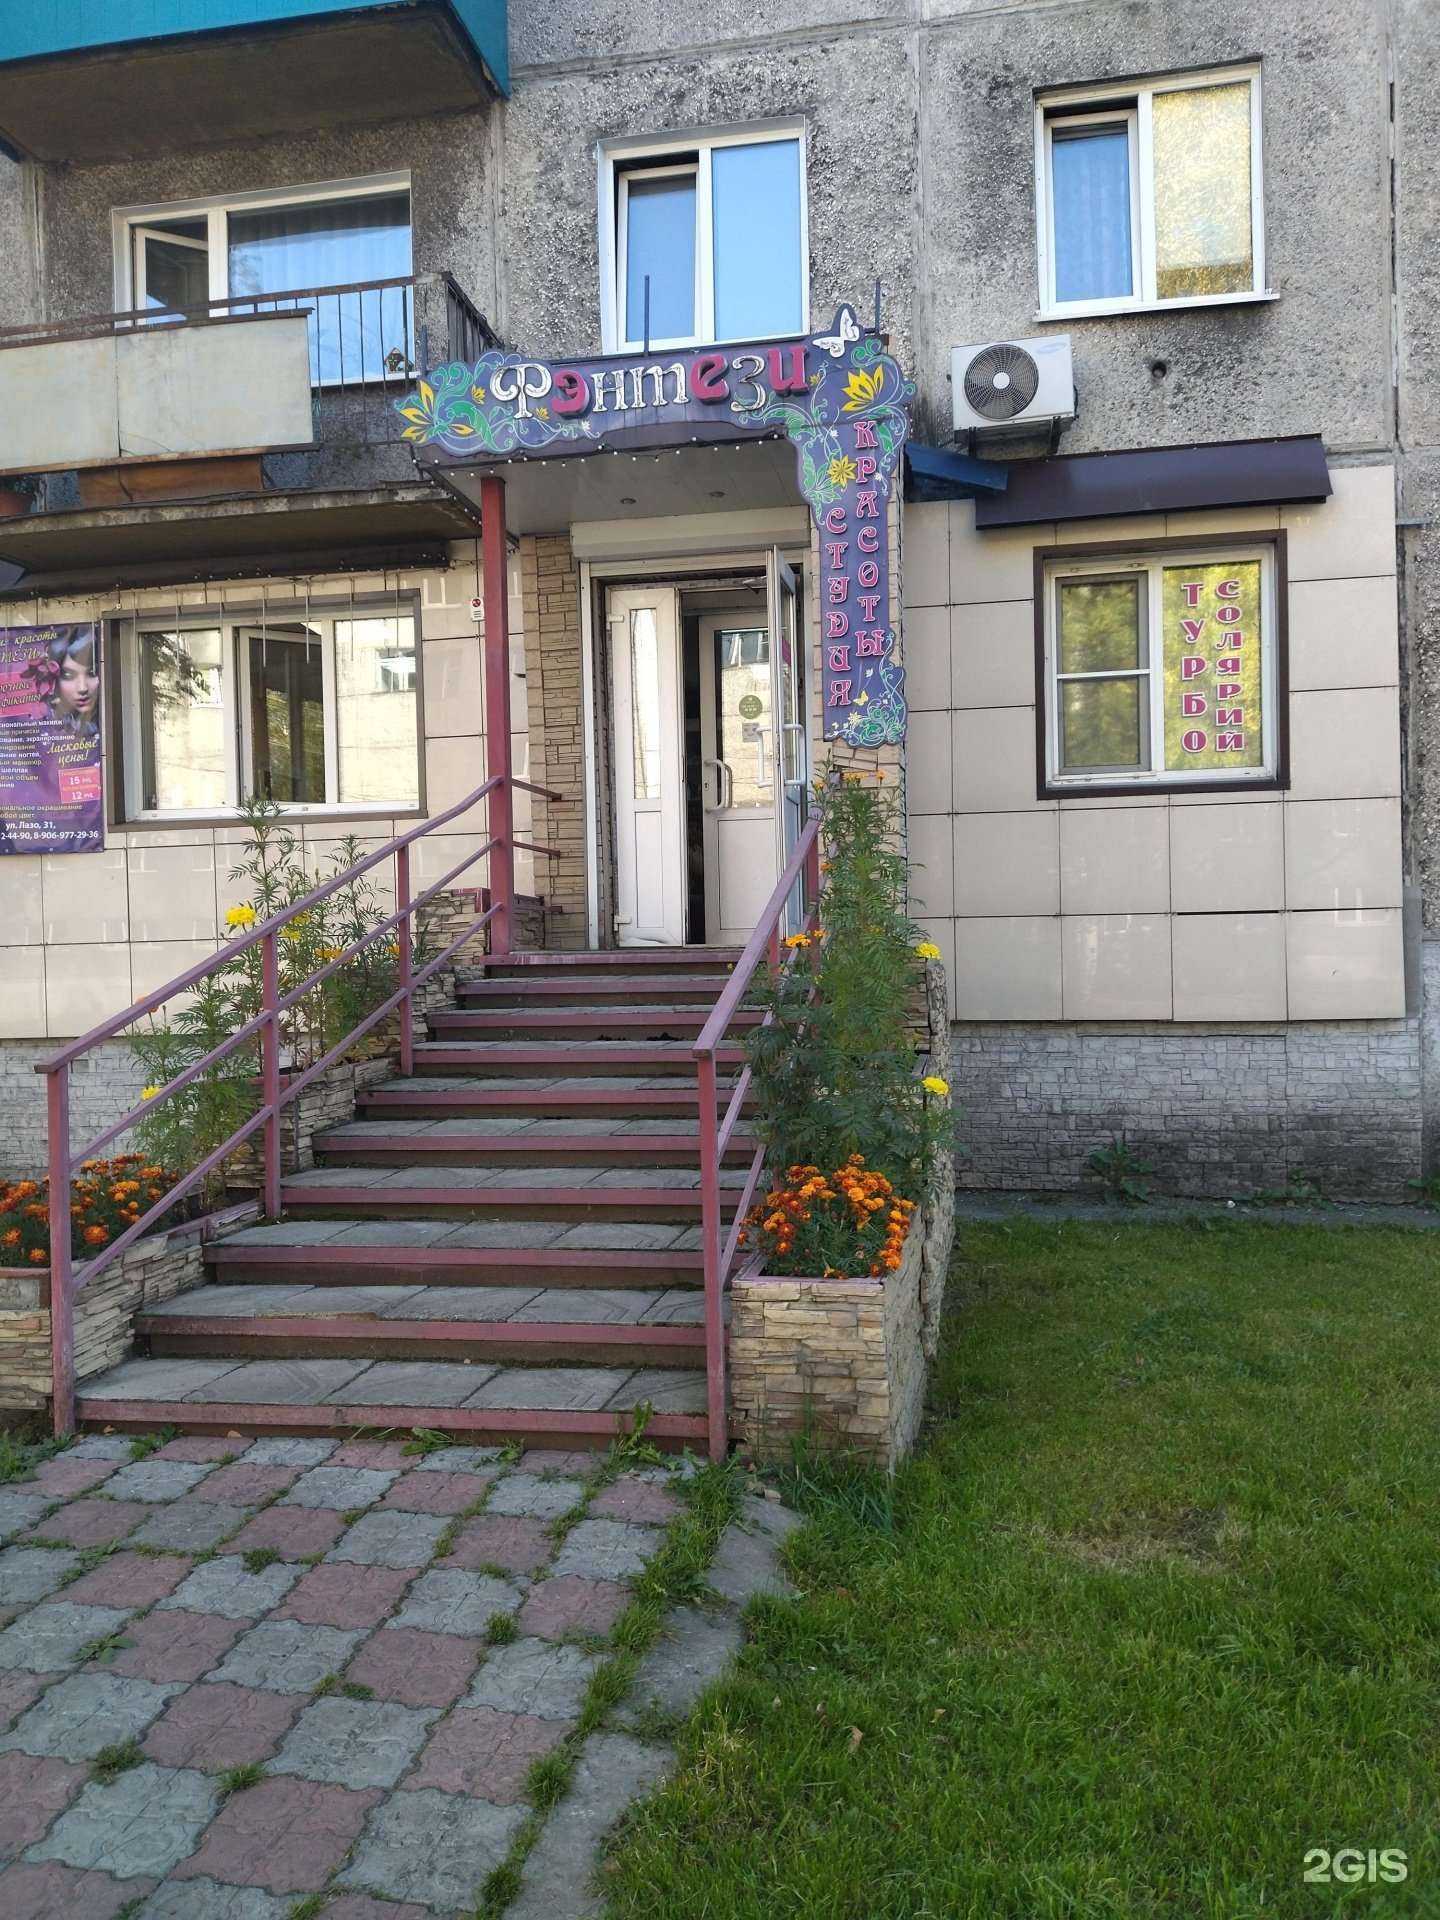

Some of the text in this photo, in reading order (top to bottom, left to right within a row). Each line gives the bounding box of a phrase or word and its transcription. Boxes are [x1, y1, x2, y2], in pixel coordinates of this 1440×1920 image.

[490, 346, 812, 420] Фэнтези
[853, 420, 886, 657] КРАСОТЫ
[824, 507, 852, 706] СТУДИЯ
[1181, 582, 1209, 753] ТУРБО
[1215, 579, 1245, 753] СОЛЯРИЙ
[58, 749, 89, 767] цены!
[69, 776, 81, 786] 15
[71, 791, 83, 800] 12
[33, 830, 99, 840] 8-906-977-29-36
